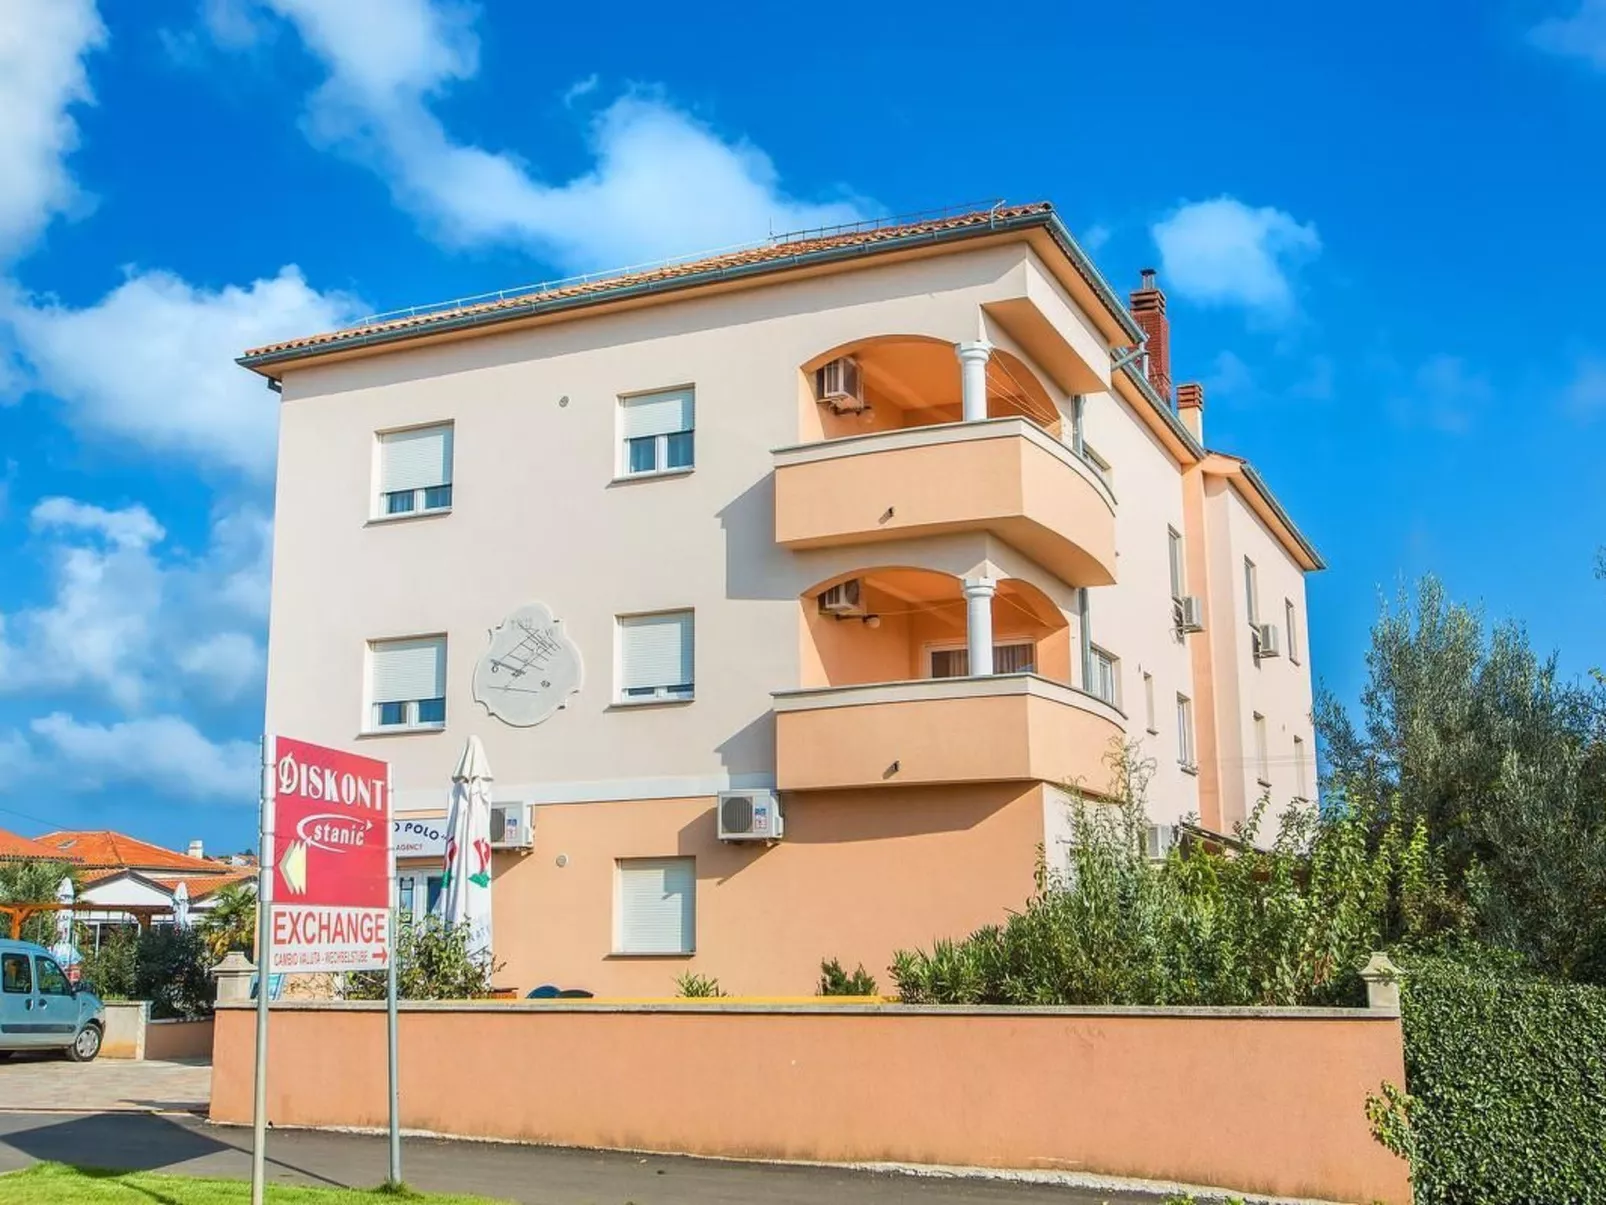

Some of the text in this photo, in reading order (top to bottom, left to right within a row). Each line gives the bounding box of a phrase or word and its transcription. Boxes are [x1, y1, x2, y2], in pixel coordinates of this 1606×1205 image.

[279, 752, 385, 811] DISKONT
[314, 822, 365, 846] stanić
[404, 822, 440, 841] POLO
[273, 911, 386, 945] EXCHANGE
